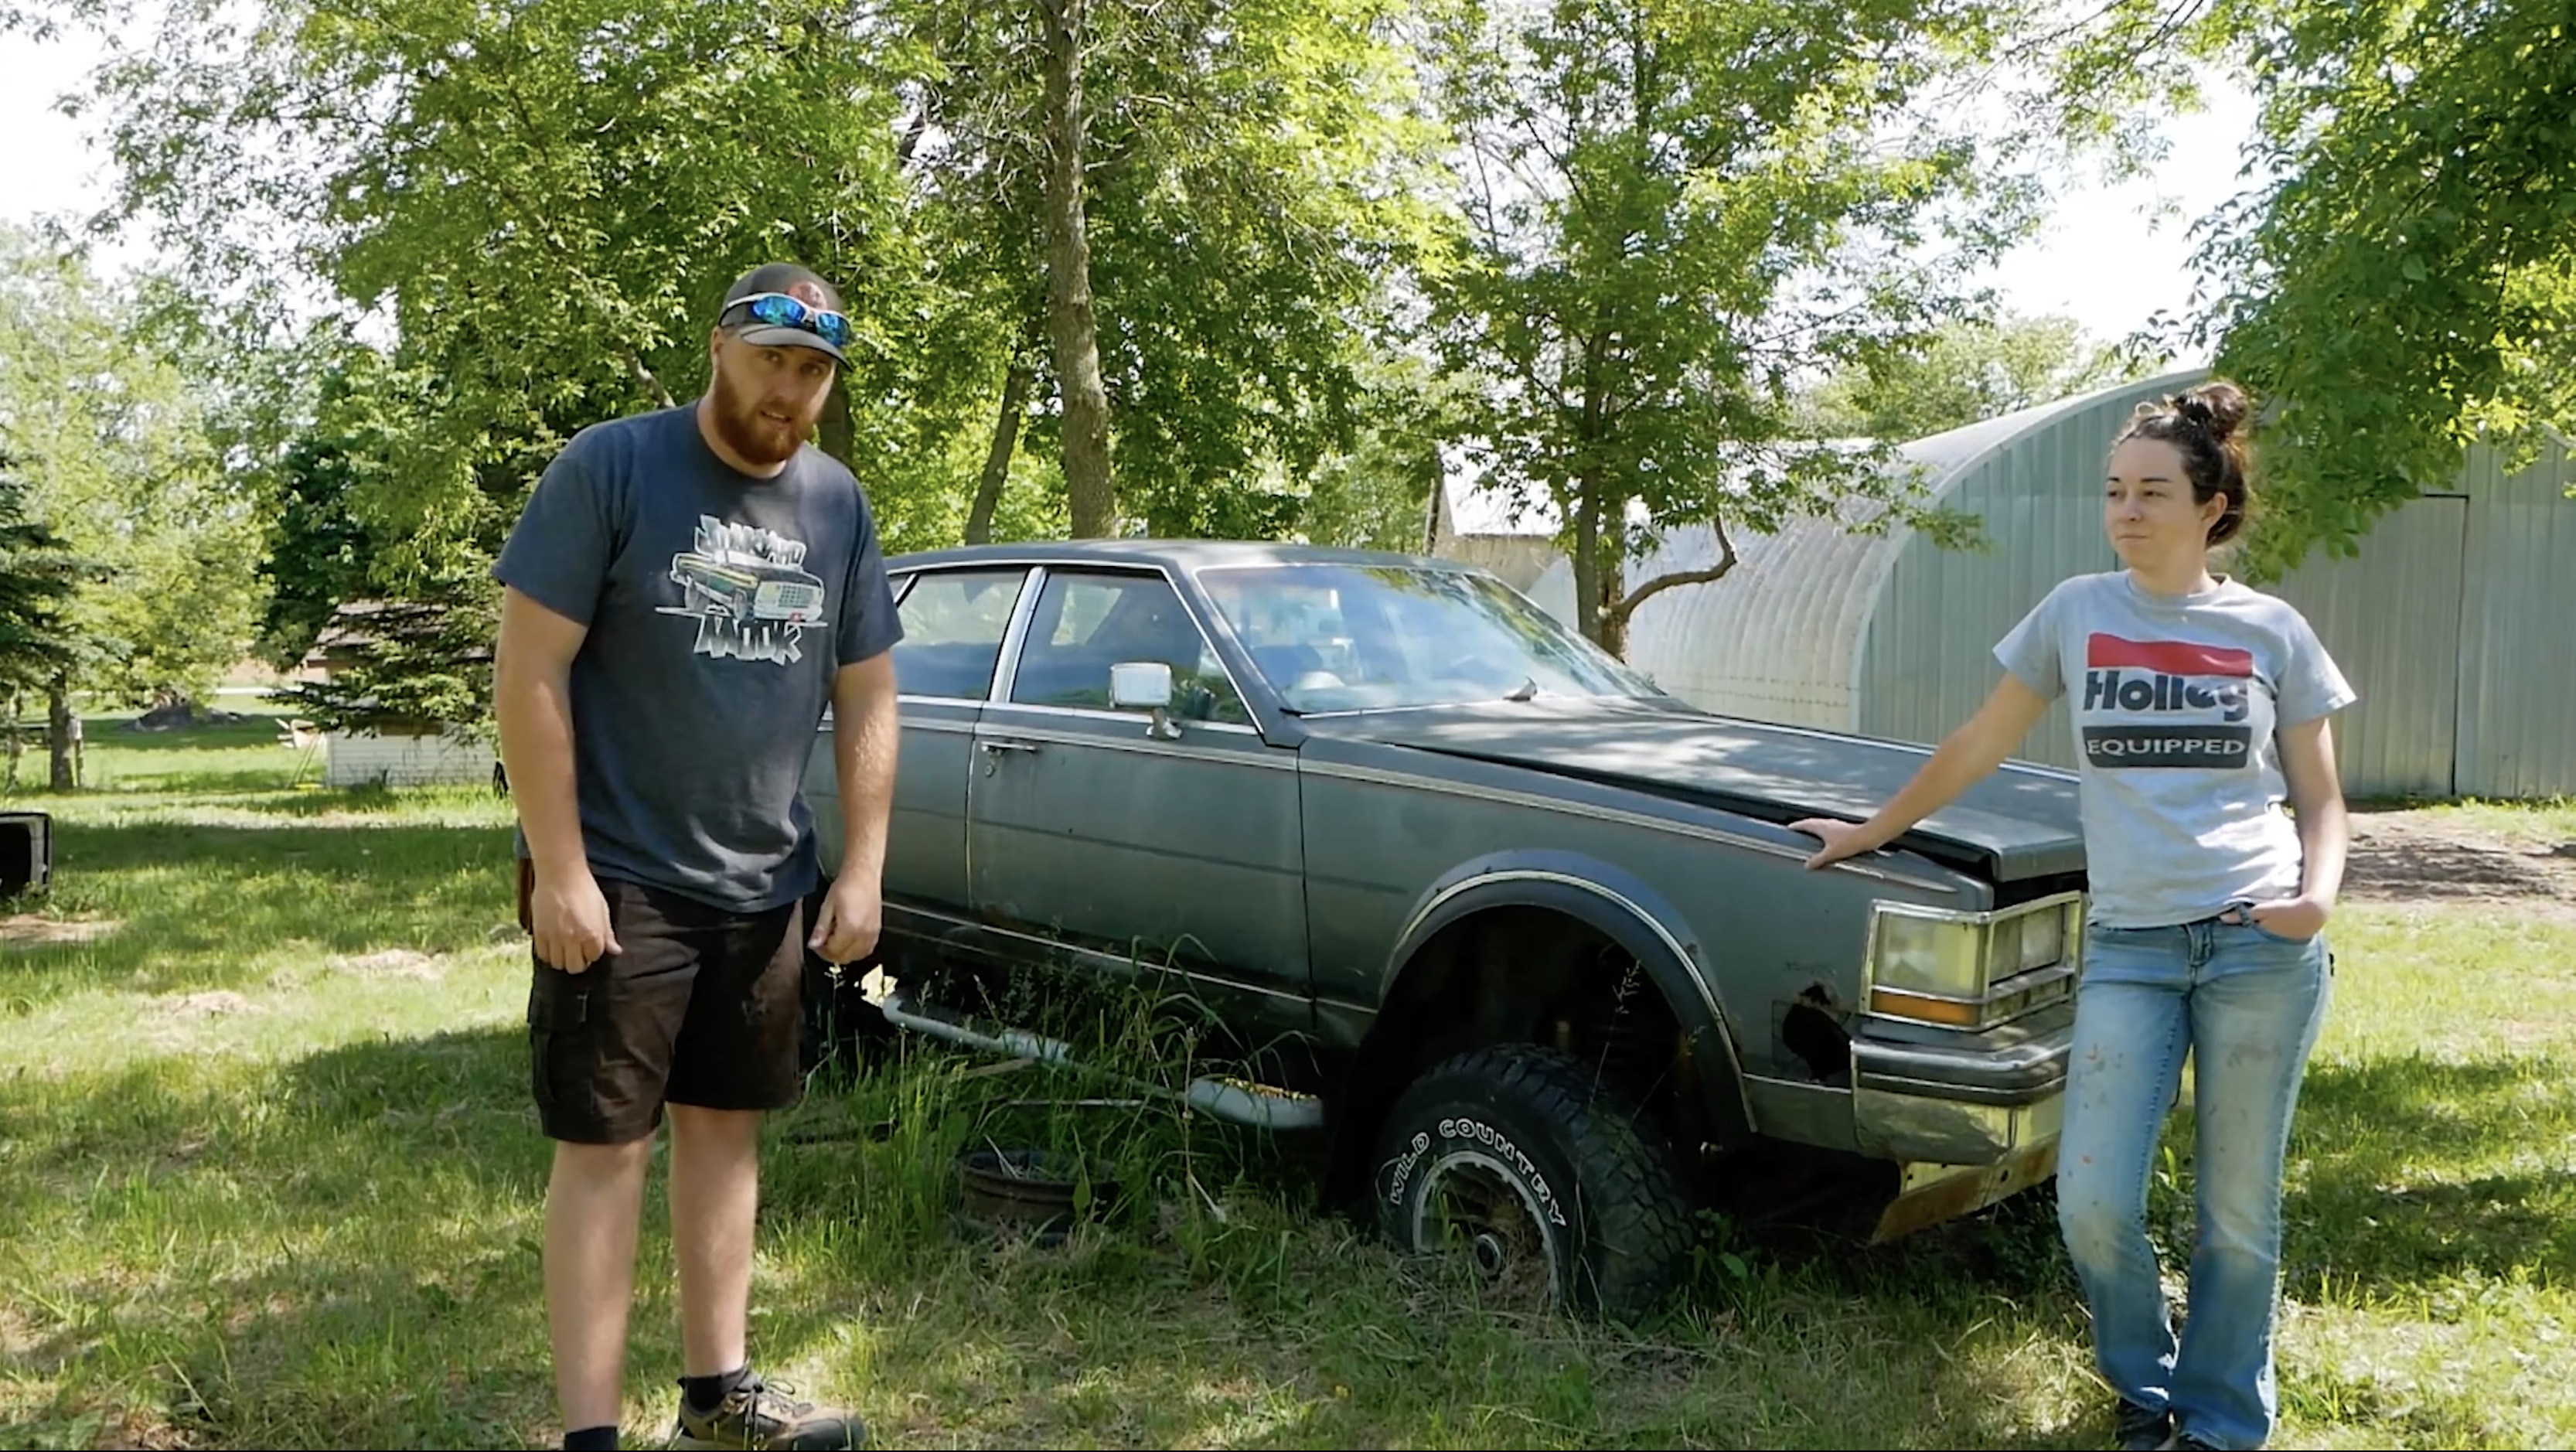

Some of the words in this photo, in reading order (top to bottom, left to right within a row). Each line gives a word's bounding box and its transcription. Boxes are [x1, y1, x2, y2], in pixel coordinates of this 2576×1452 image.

[2083, 670, 2250, 722] Holley
[2087, 738, 2246, 756] EQUIPPED
[1389, 1131, 1430, 1206] WILD
[1438, 1118, 1567, 1226] COUNTRY
